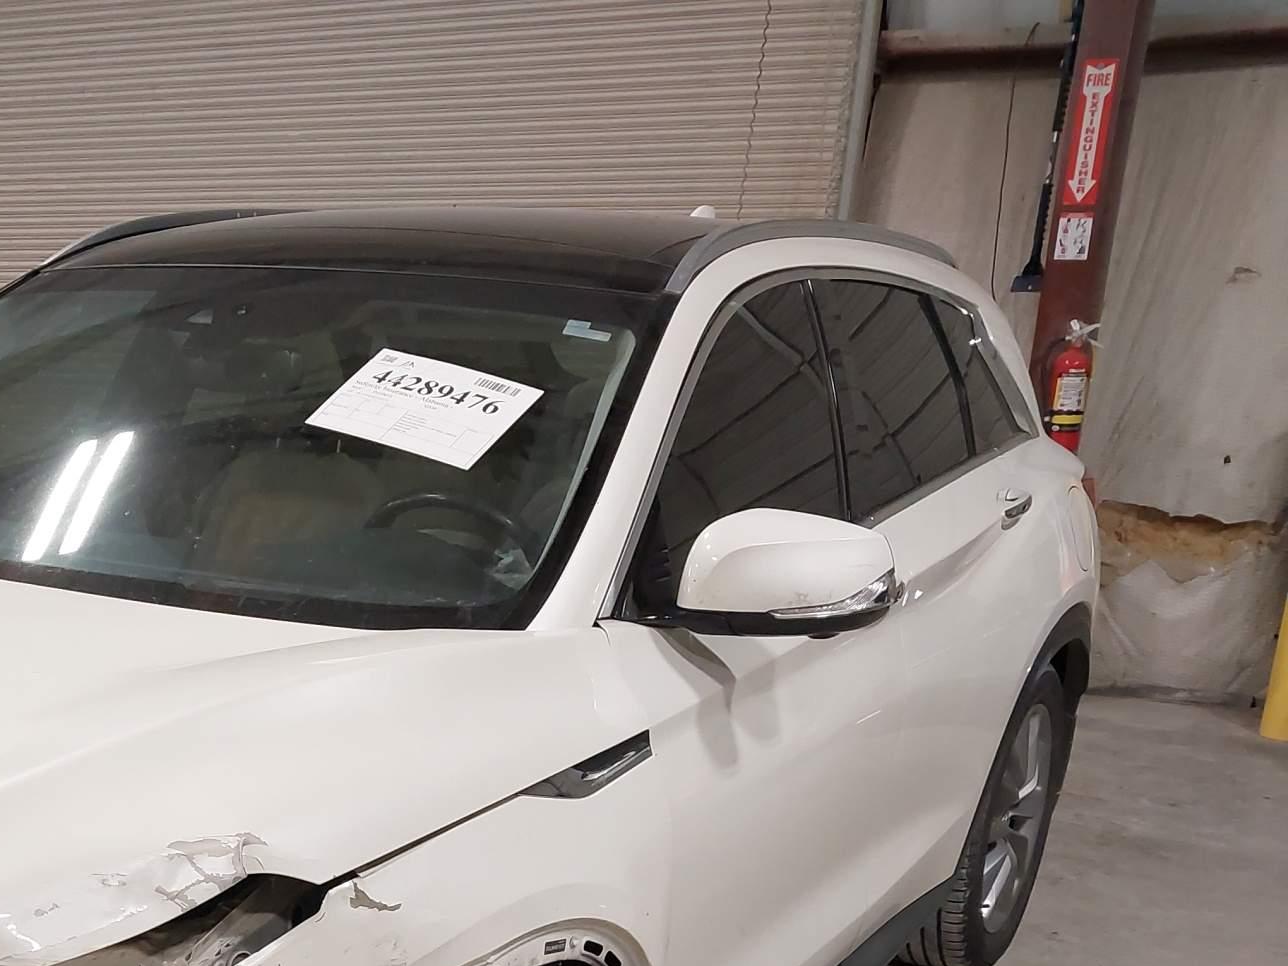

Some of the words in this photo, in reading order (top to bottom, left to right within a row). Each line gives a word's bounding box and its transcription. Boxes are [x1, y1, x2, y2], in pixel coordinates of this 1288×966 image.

[1086, 72, 1112, 88] FIRE
[1075, 92, 1100, 194] EXTINGUISHER
[372, 369, 506, 416] 44289476
